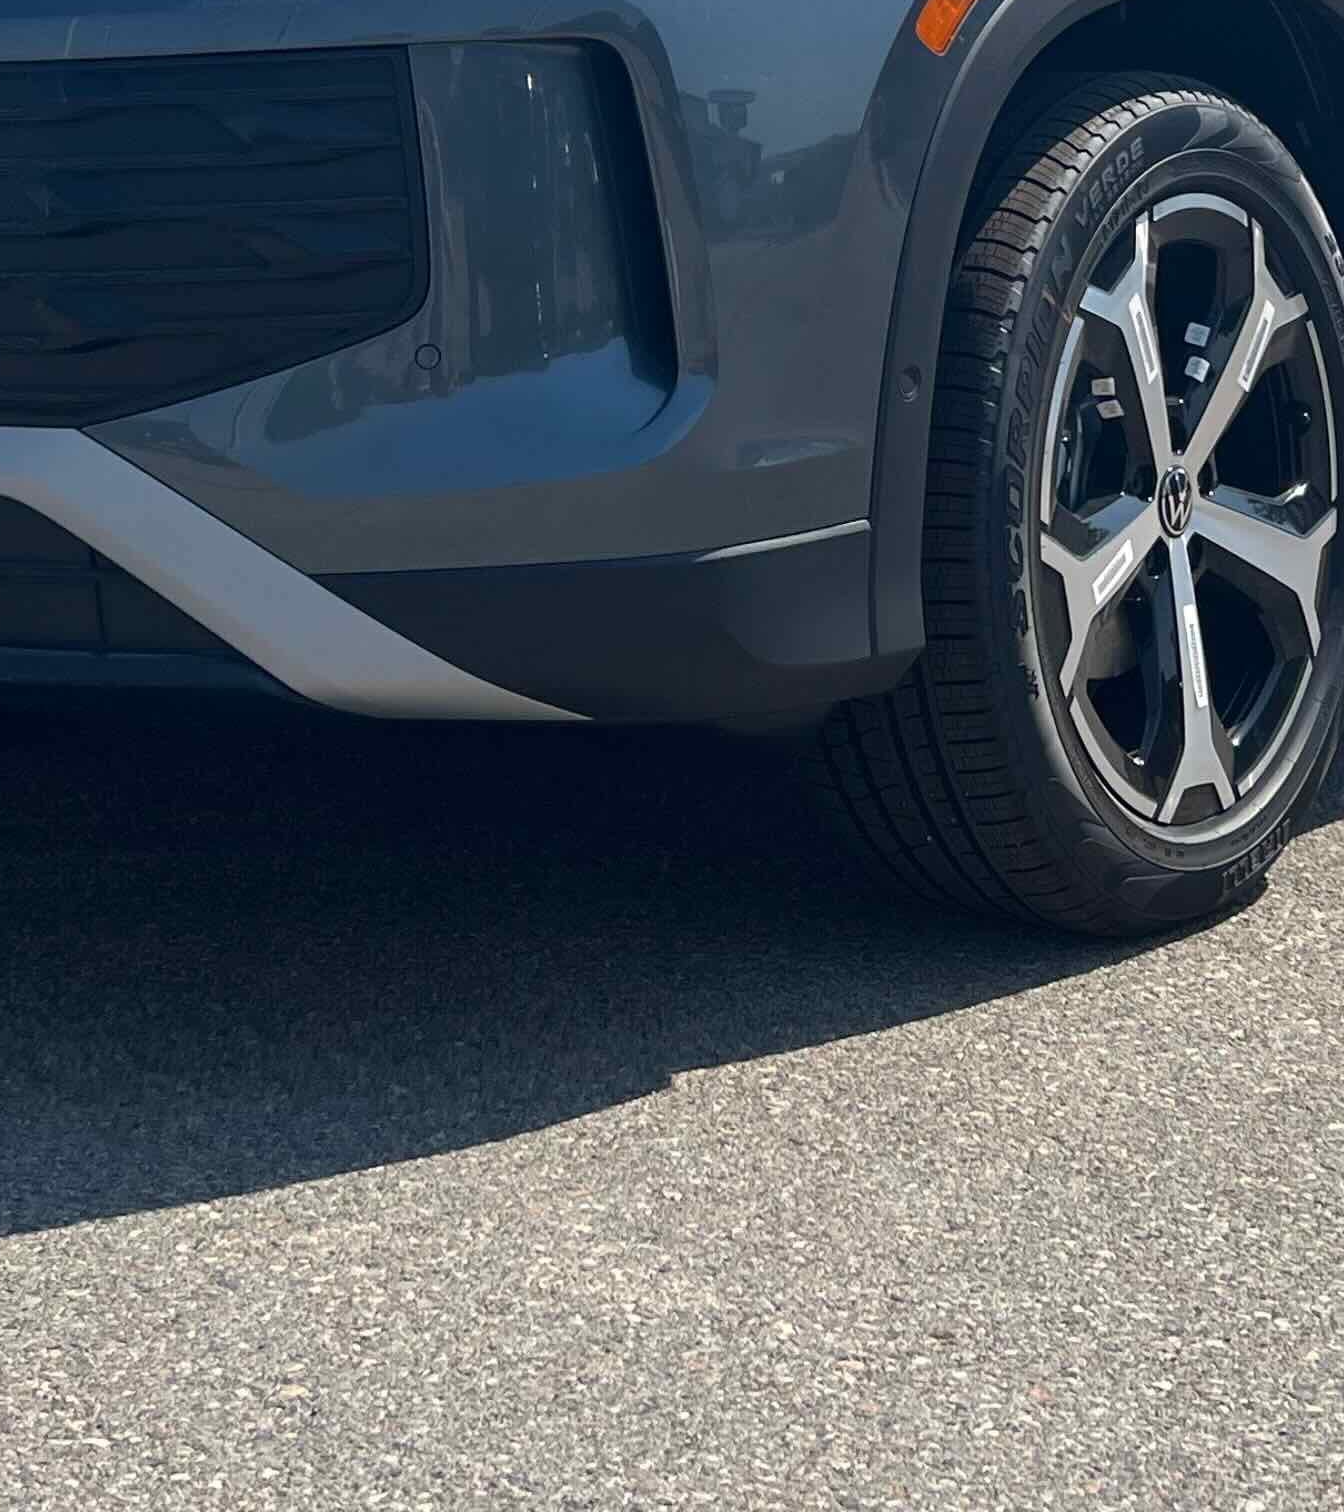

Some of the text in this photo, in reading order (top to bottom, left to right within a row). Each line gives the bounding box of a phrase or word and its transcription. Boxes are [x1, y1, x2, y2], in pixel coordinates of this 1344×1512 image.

[1004, 230, 1074, 638] SCORPION
[1075, 135, 1145, 228] VERDE
[1164, 470, 1192, 531] VW
